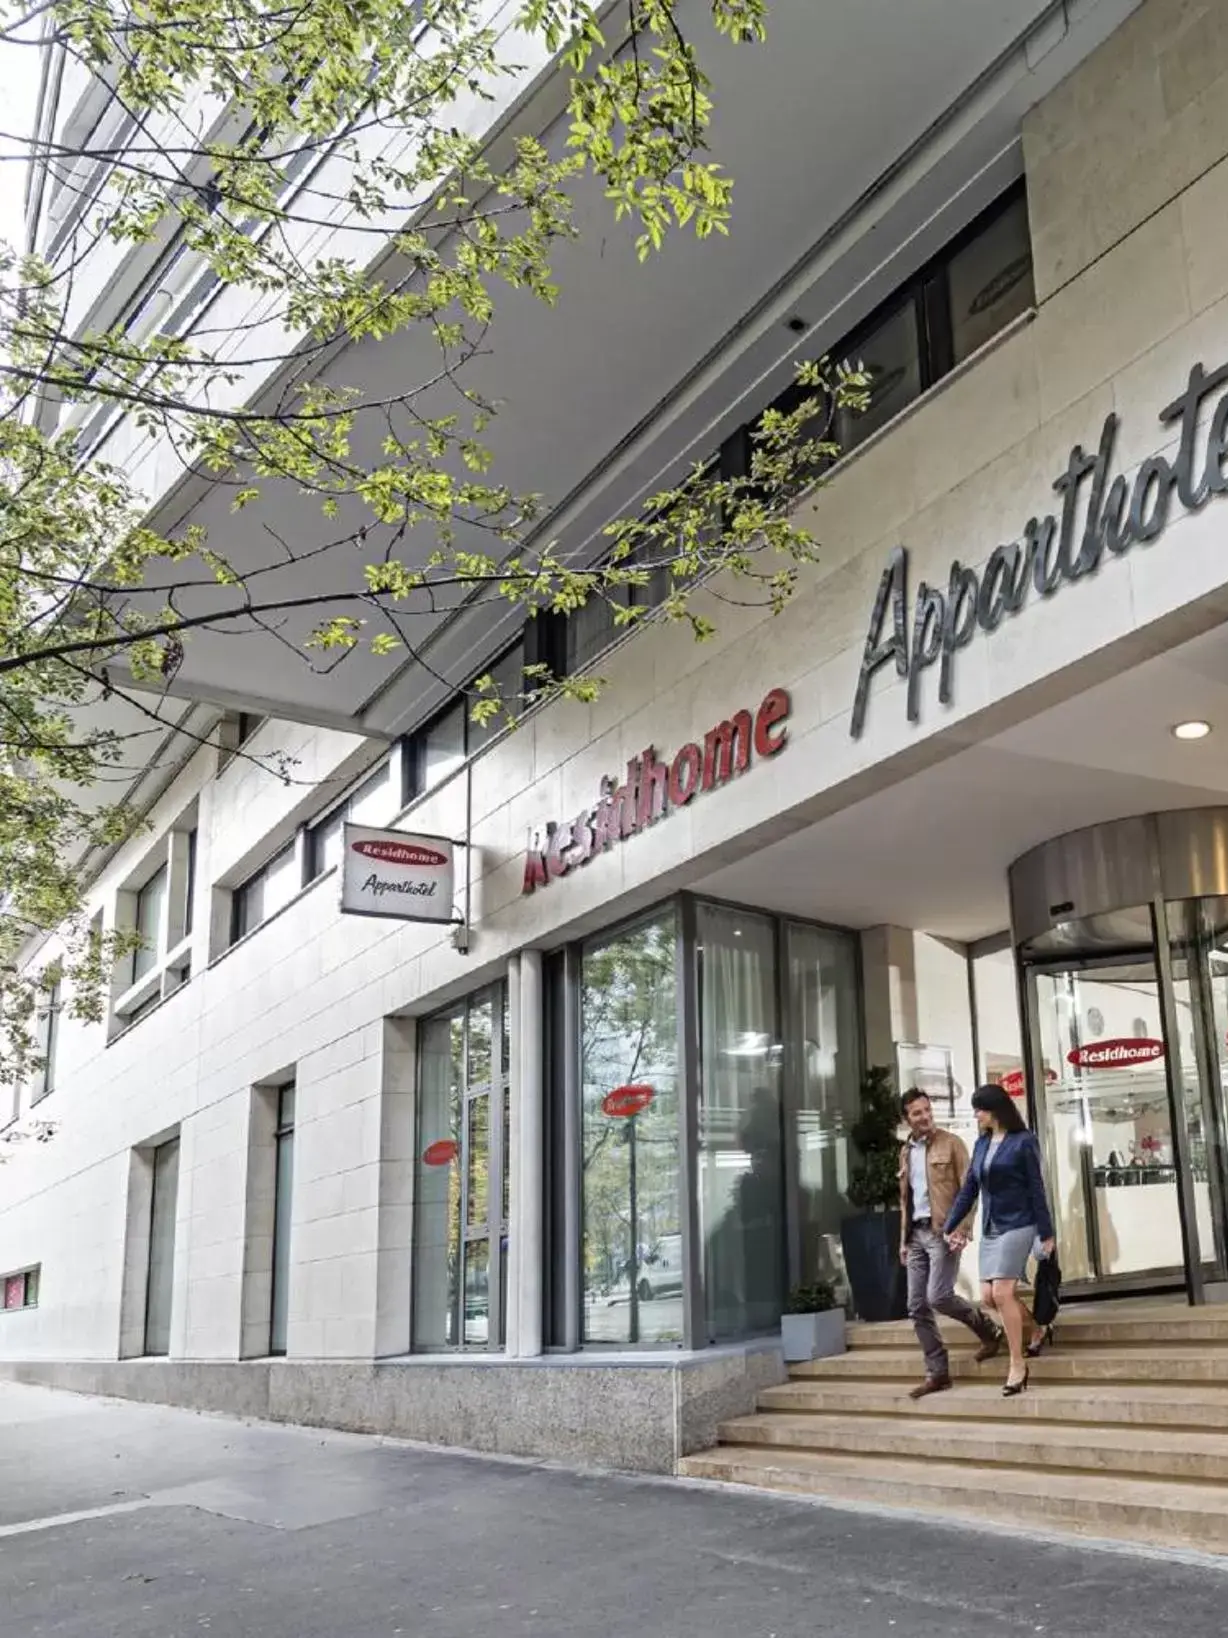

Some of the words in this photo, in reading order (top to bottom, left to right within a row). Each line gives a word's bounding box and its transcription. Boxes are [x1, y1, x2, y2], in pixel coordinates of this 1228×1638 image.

[522, 687, 790, 894] Residhome
[363, 844, 438, 863] Residhome
[362, 874, 437, 896] Apparthotel
[1079, 1046, 1160, 1063] Residhome
